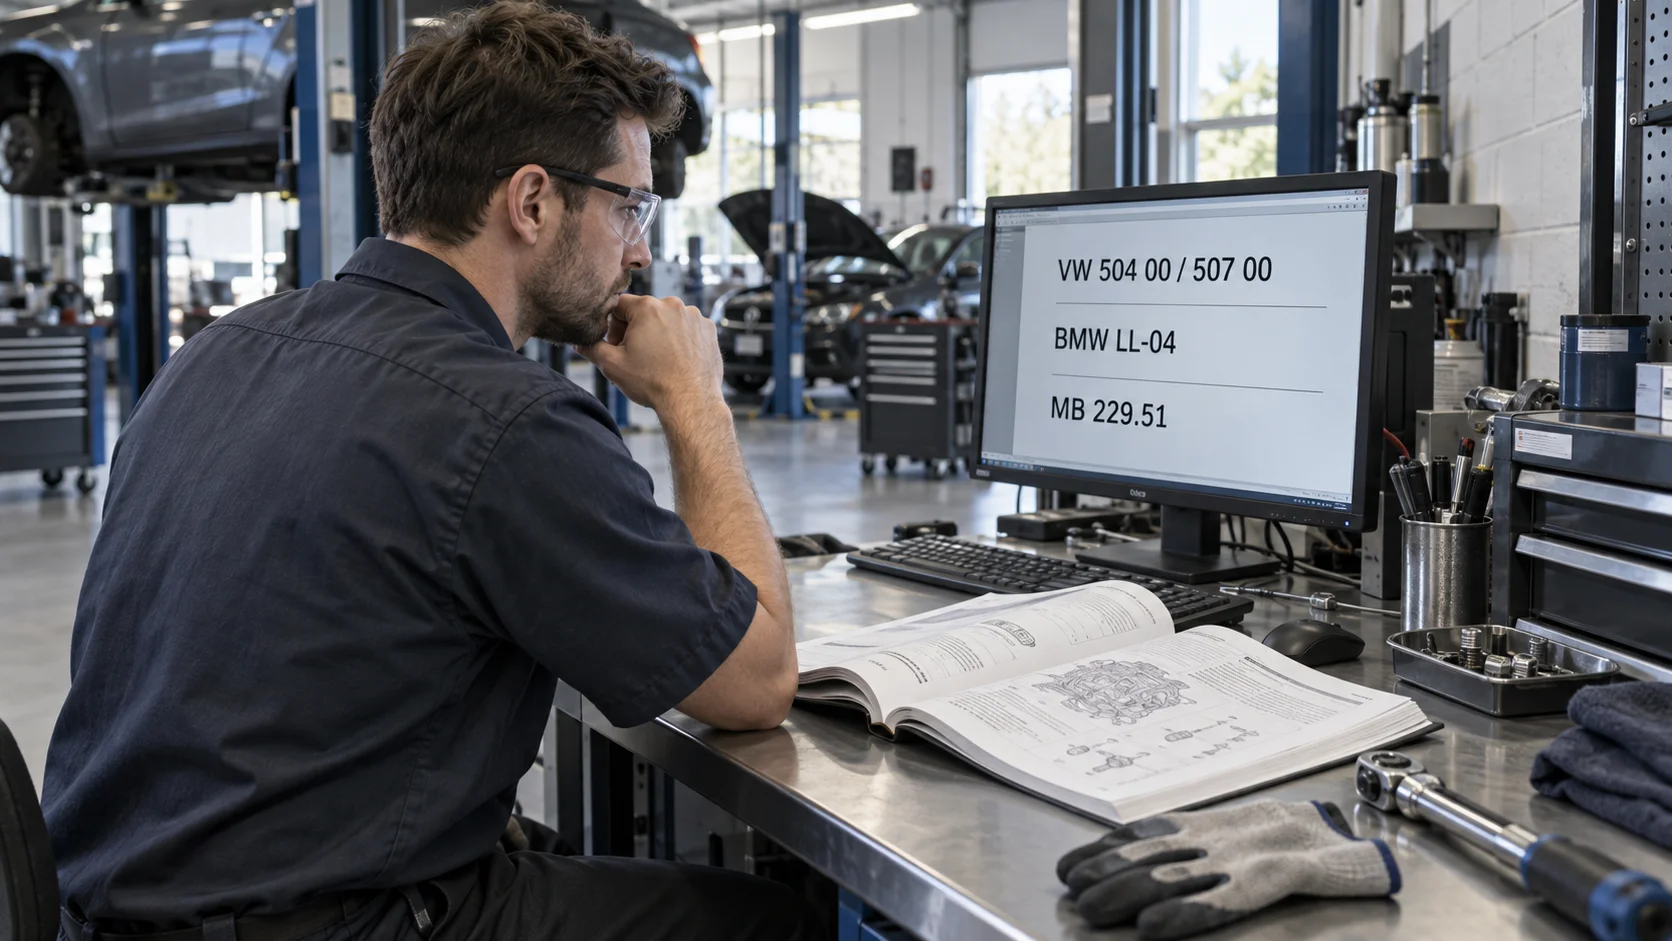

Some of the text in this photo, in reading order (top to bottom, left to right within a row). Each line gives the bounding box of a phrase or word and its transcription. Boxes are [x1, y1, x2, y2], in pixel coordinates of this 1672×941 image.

[1058, 256, 1273, 283] VW 504 00 / 507 00
[1054, 326, 1177, 354] BMW LL-04
[1051, 395, 1167, 429] MB 229.51
